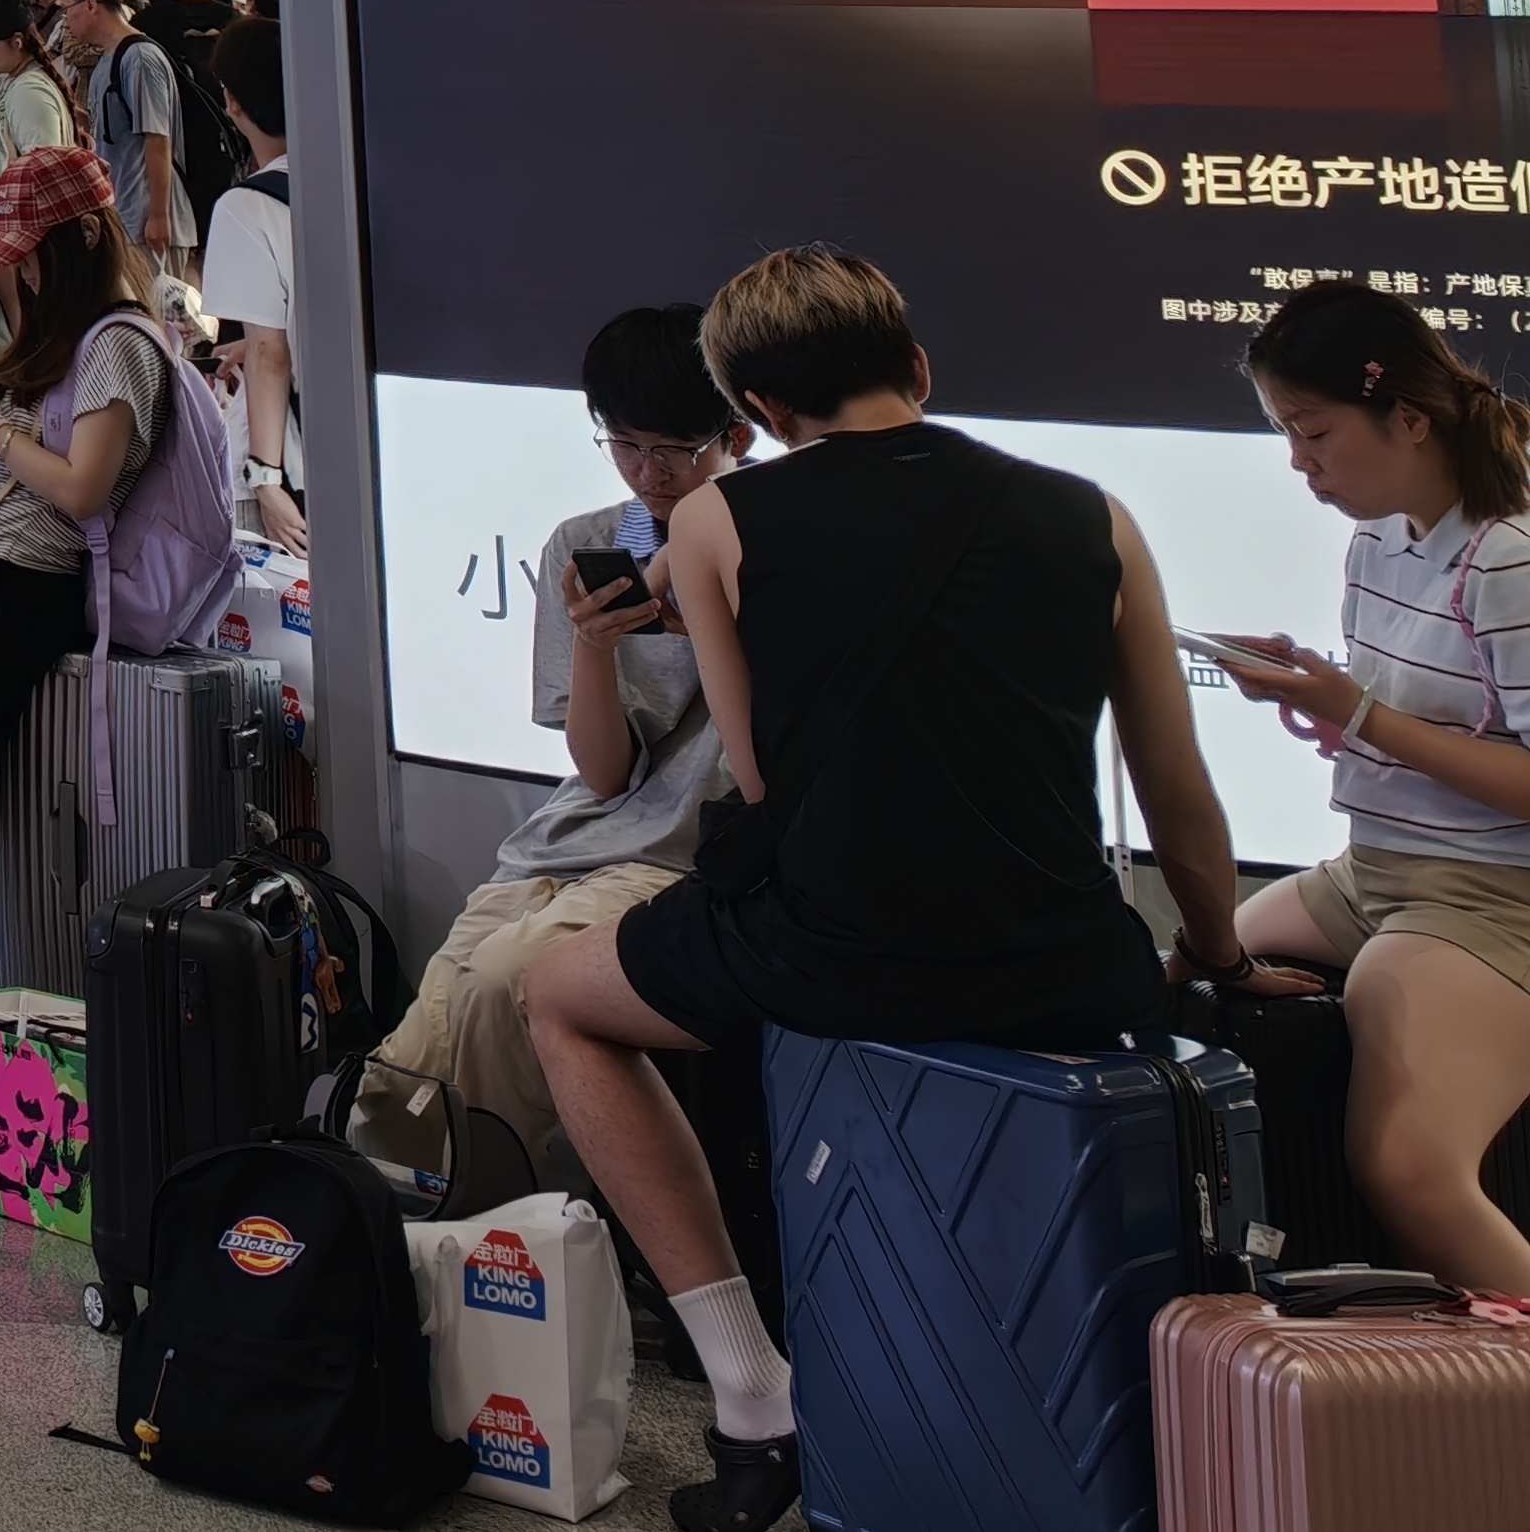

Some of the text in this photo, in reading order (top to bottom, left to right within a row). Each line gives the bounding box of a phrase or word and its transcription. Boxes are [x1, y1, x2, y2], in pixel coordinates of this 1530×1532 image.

[219, 635, 245, 652] KING
[227, 1233, 297, 1258] Dickies
[477, 1263, 531, 1289] KING
[473, 1281, 537, 1310] LOMO
[481, 1429, 535, 1457] KING
[478, 1448, 541, 1477] LOMO
